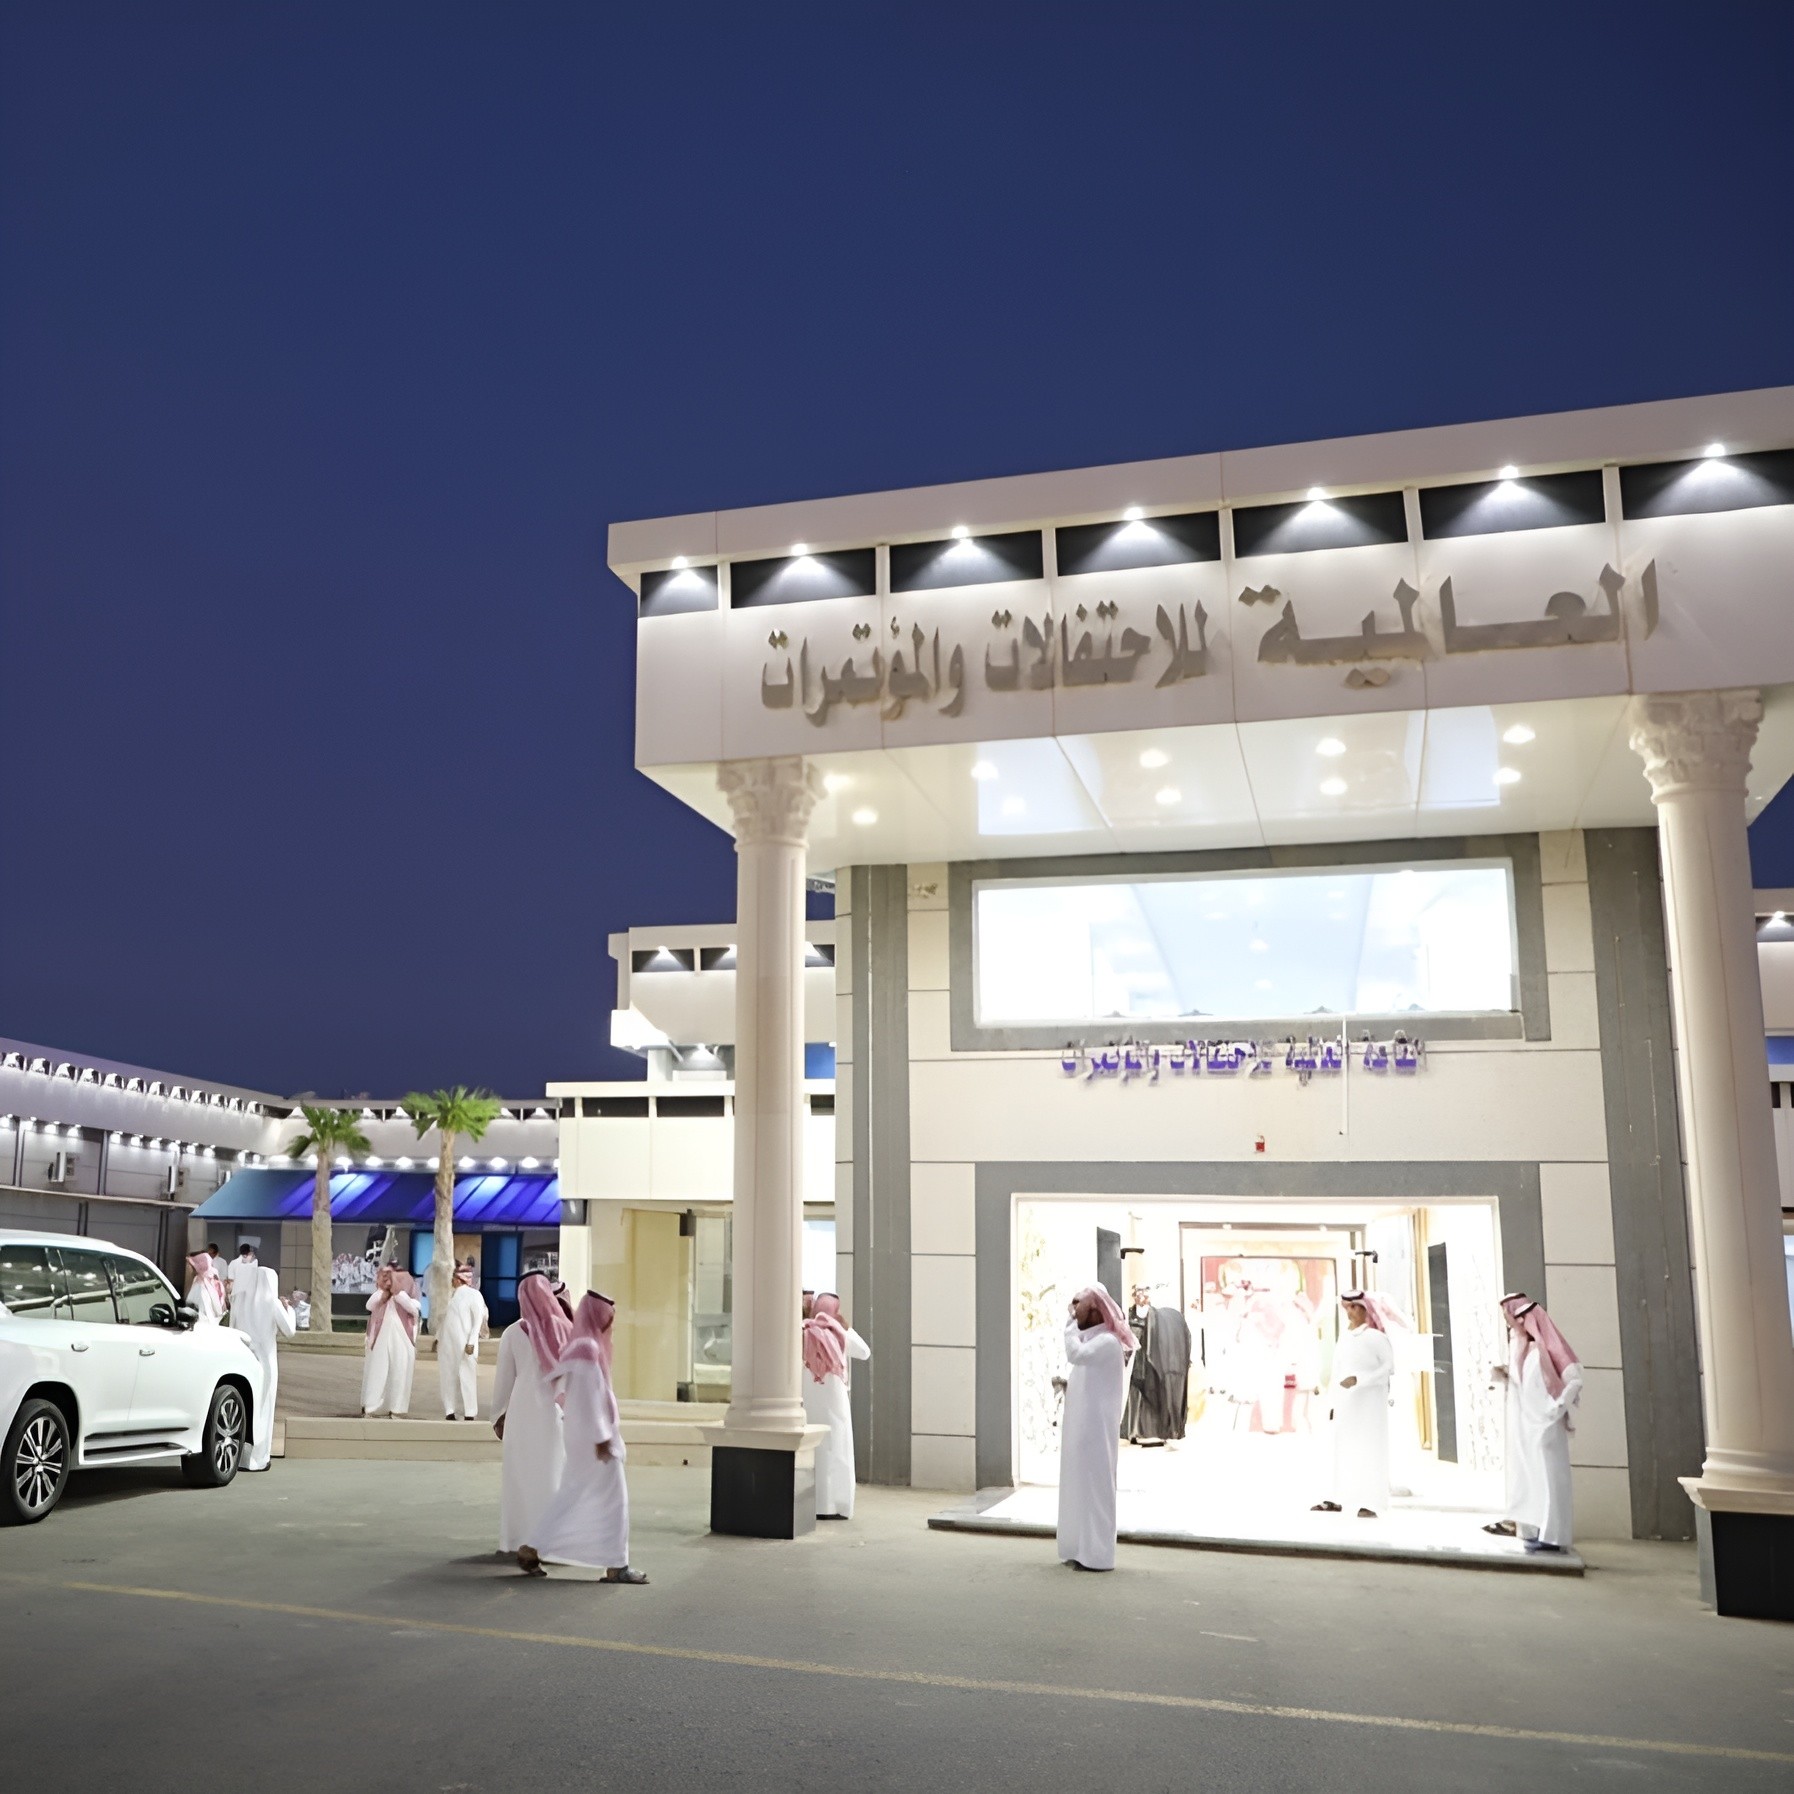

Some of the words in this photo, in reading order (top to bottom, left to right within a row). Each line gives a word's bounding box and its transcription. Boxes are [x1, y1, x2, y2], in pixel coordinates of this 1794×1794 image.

[760, 616, 966, 727] والمؤتمرات
[984, 599, 1208, 691] للاحتفالات
[1238, 557, 1659, 688] العالمية
